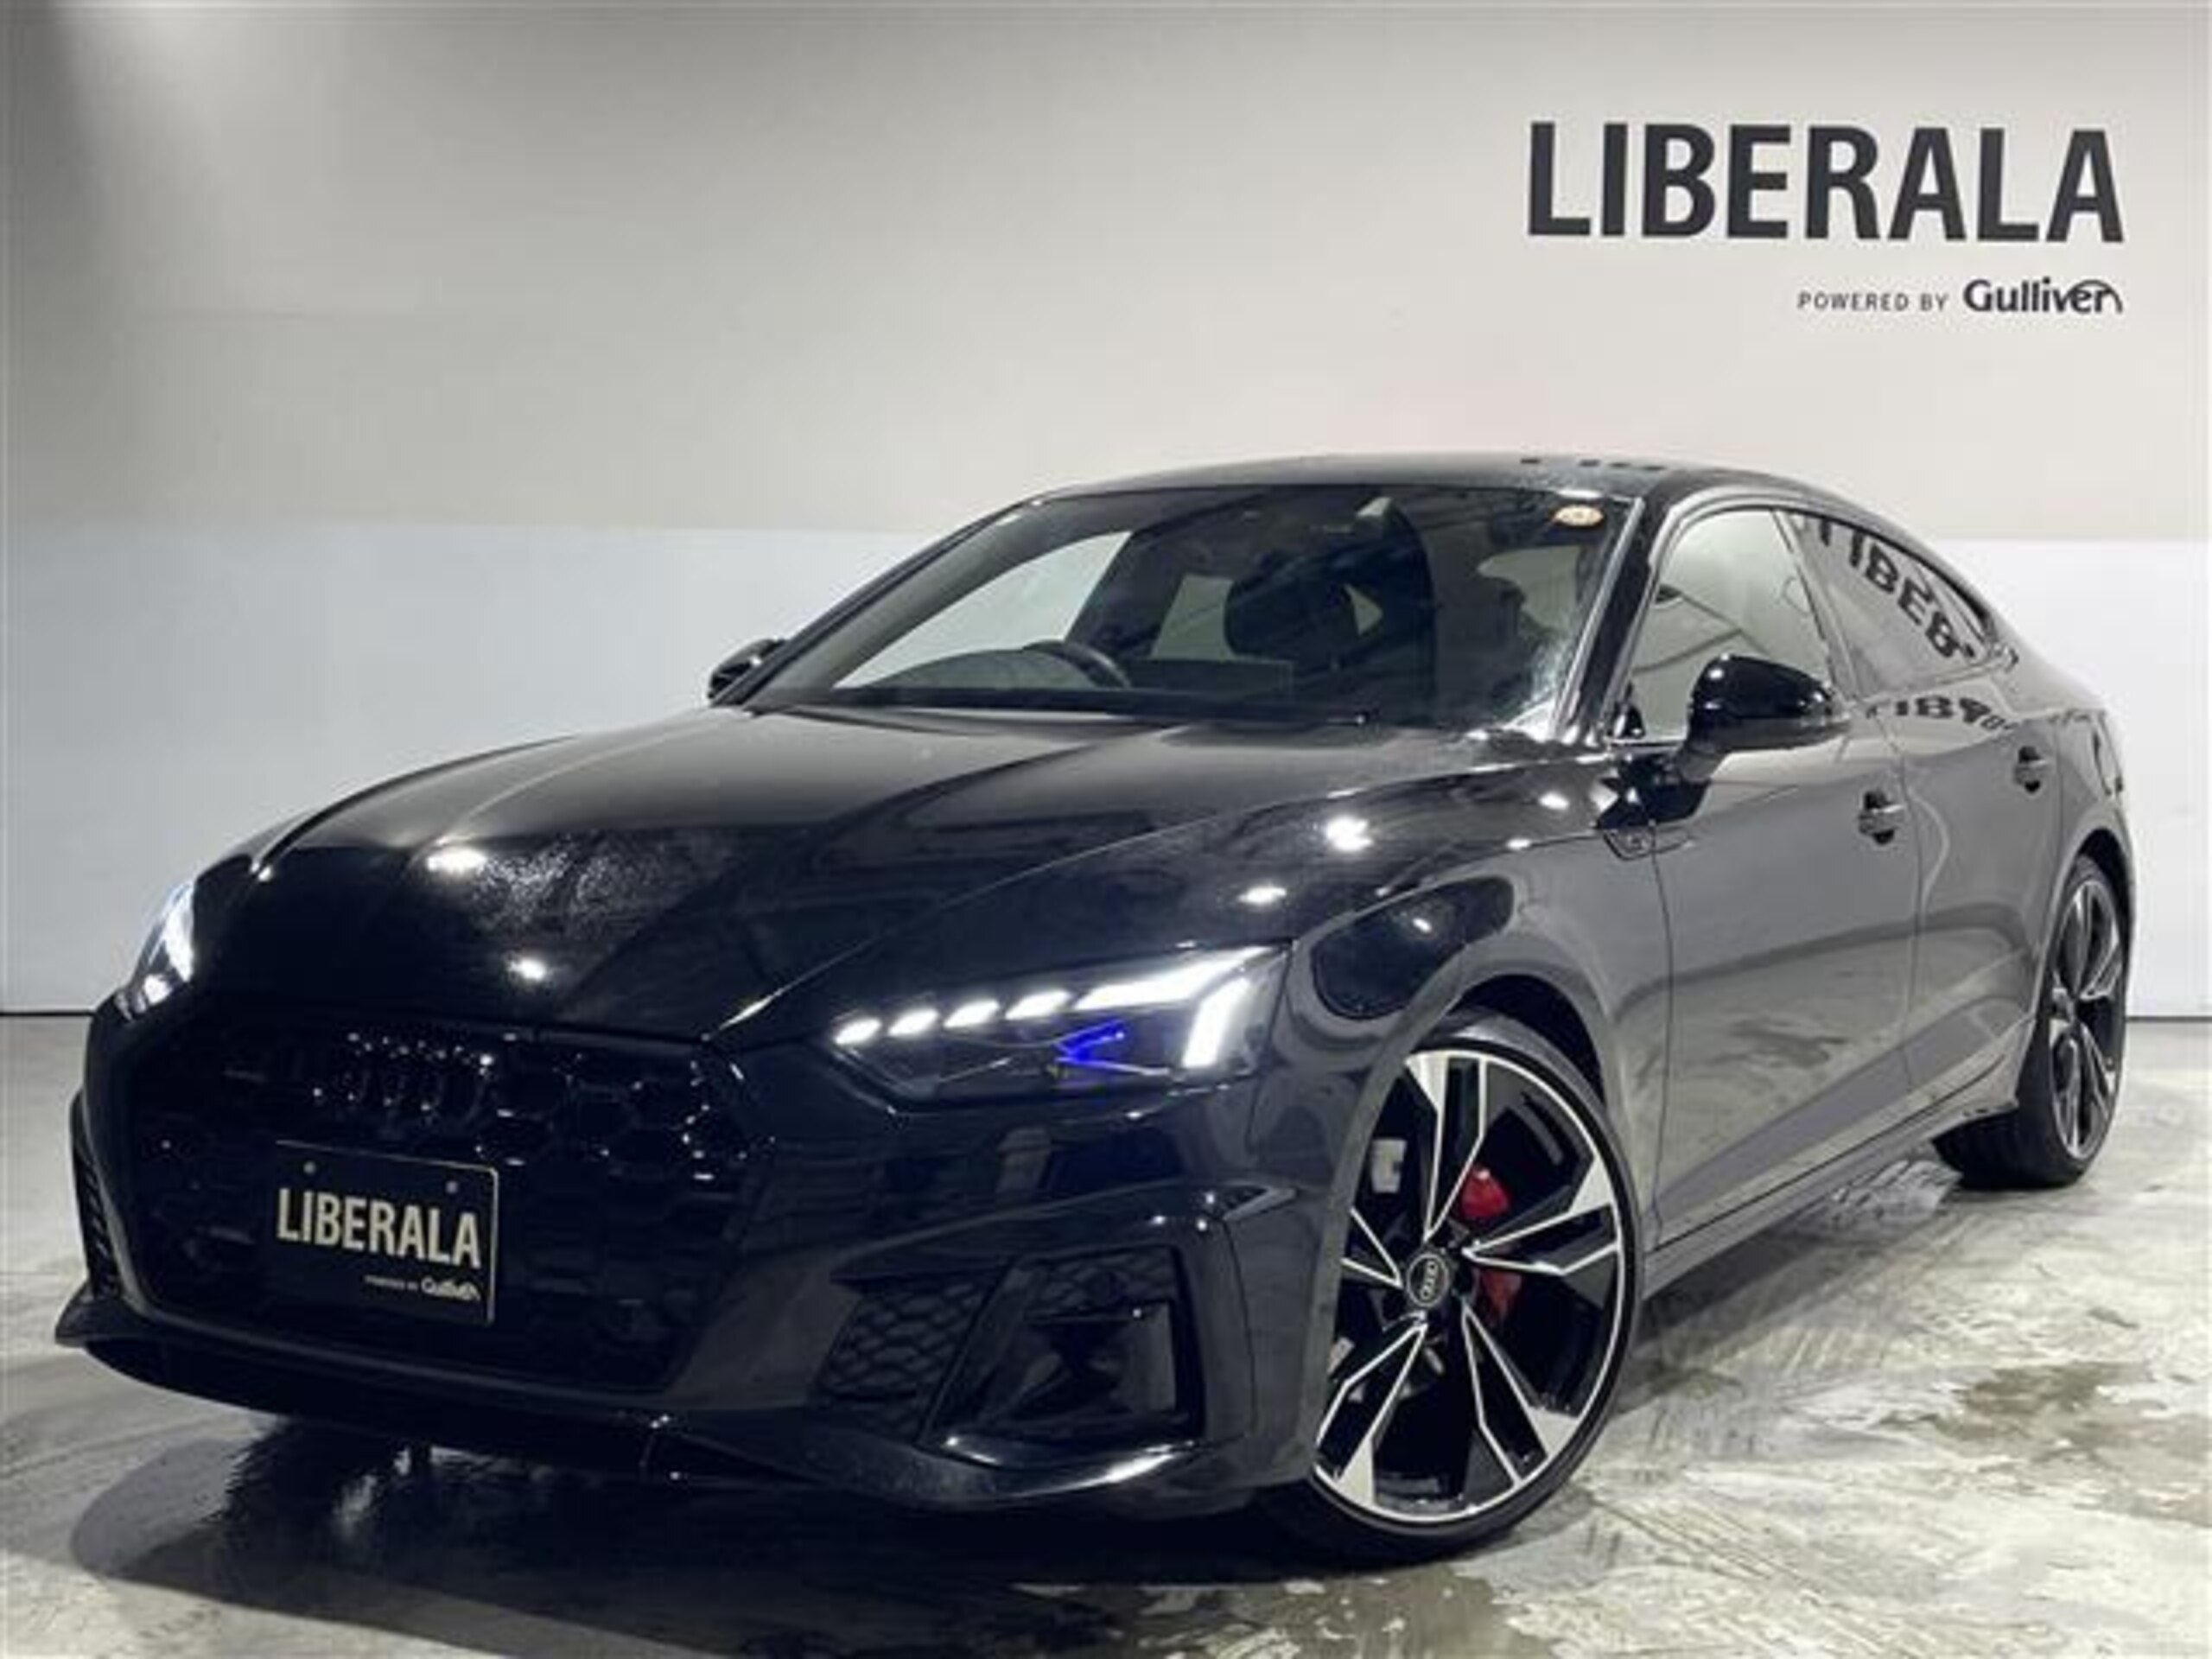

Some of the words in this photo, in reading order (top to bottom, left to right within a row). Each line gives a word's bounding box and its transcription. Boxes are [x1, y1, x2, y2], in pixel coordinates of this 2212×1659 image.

[1528, 121, 2124, 243] LIBERALA
[1796, 291, 1910, 312] POWERED
[1919, 292, 1949, 312] BY
[1962, 276, 2123, 314] Gulliver
[276, 1187, 481, 1269] LIBERALA
